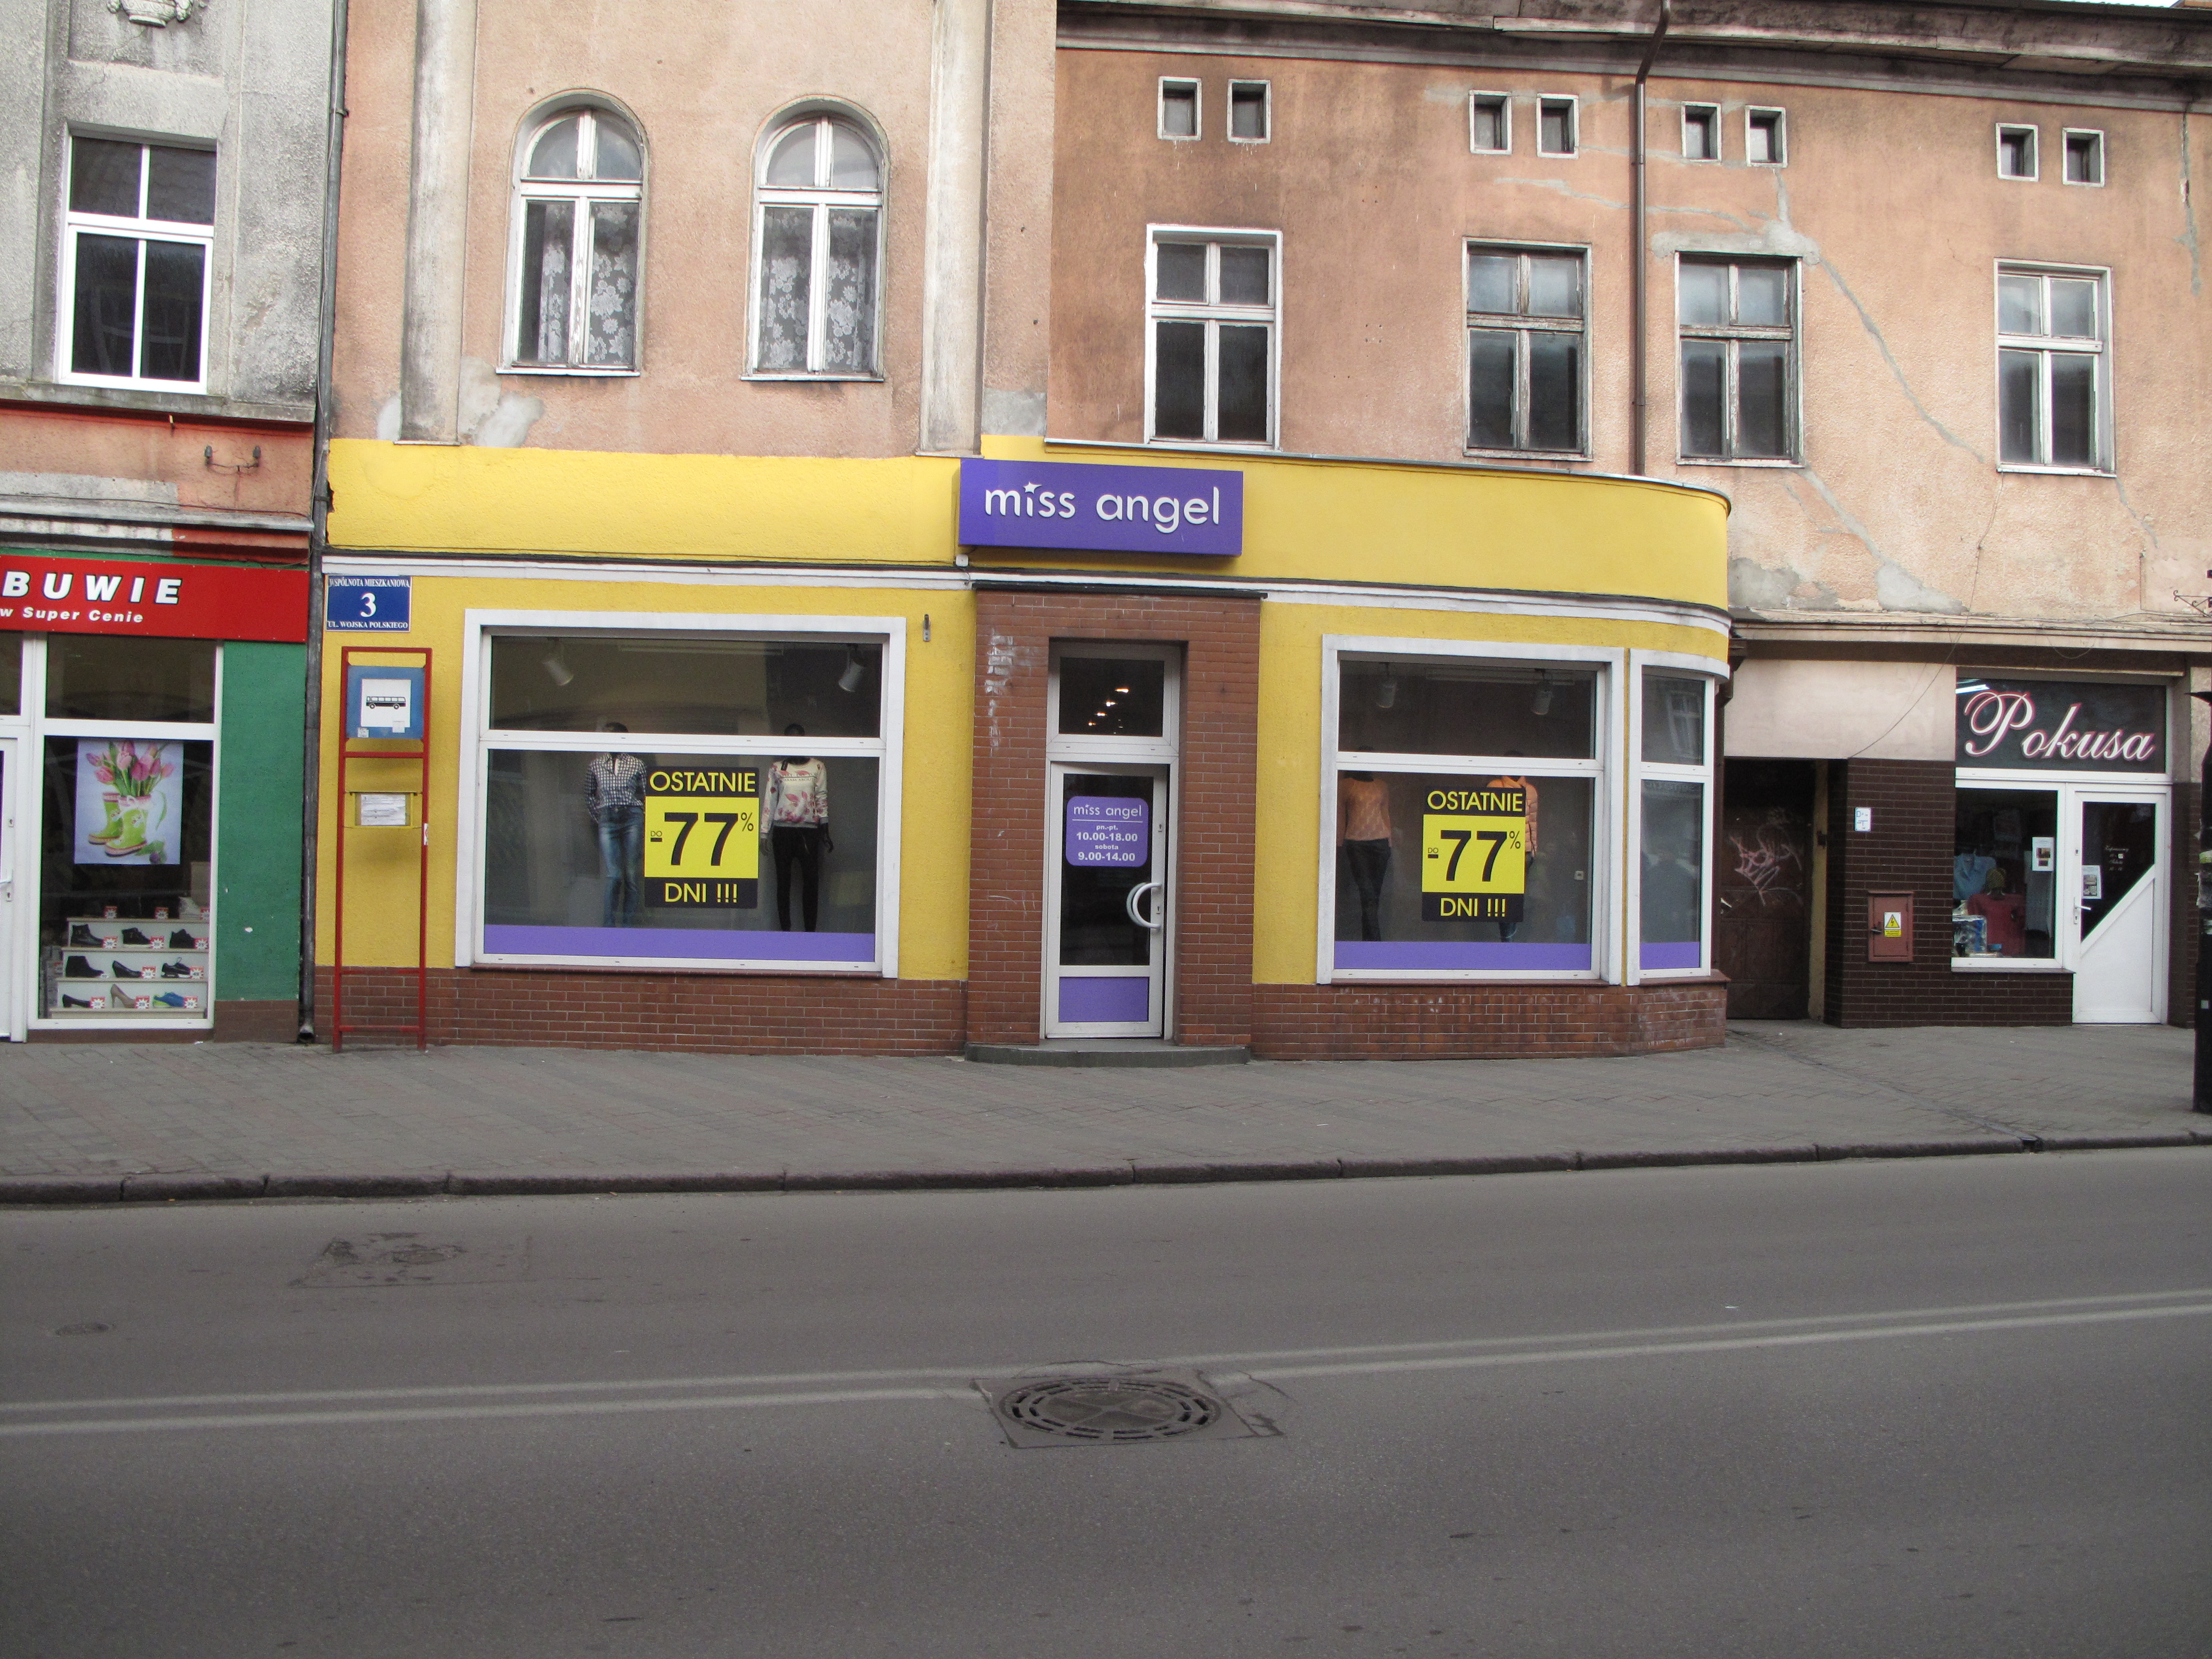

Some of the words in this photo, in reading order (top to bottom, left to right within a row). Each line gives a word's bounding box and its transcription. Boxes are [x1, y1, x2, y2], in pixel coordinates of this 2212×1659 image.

[985, 481, 1076, 519] miss
[1095, 485, 1219, 534] angel
[1, 570, 182, 604] BUWIE
[329, 577, 364, 587] WSPÓLNOTA
[364, 578, 410, 587] MIESZKANIOWA
[23, 607, 80, 621] Super
[89, 610, 144, 623] Cenie
[360, 592, 376, 618] 3
[1963, 690, 2156, 761] Pokusa
[650, 771, 756, 792] OSTATNIE
[1427, 790, 1523, 812] OSTATNIE
[1073, 804, 1100, 815] miss
[1105, 805, 1142, 819] angel
[1076, 832, 1138, 842] 10.00-18.00
[1077, 852, 1136, 862] 9.00-14.00
[665, 883, 707, 903] DNI
[1440, 898, 1478, 917] DNI
